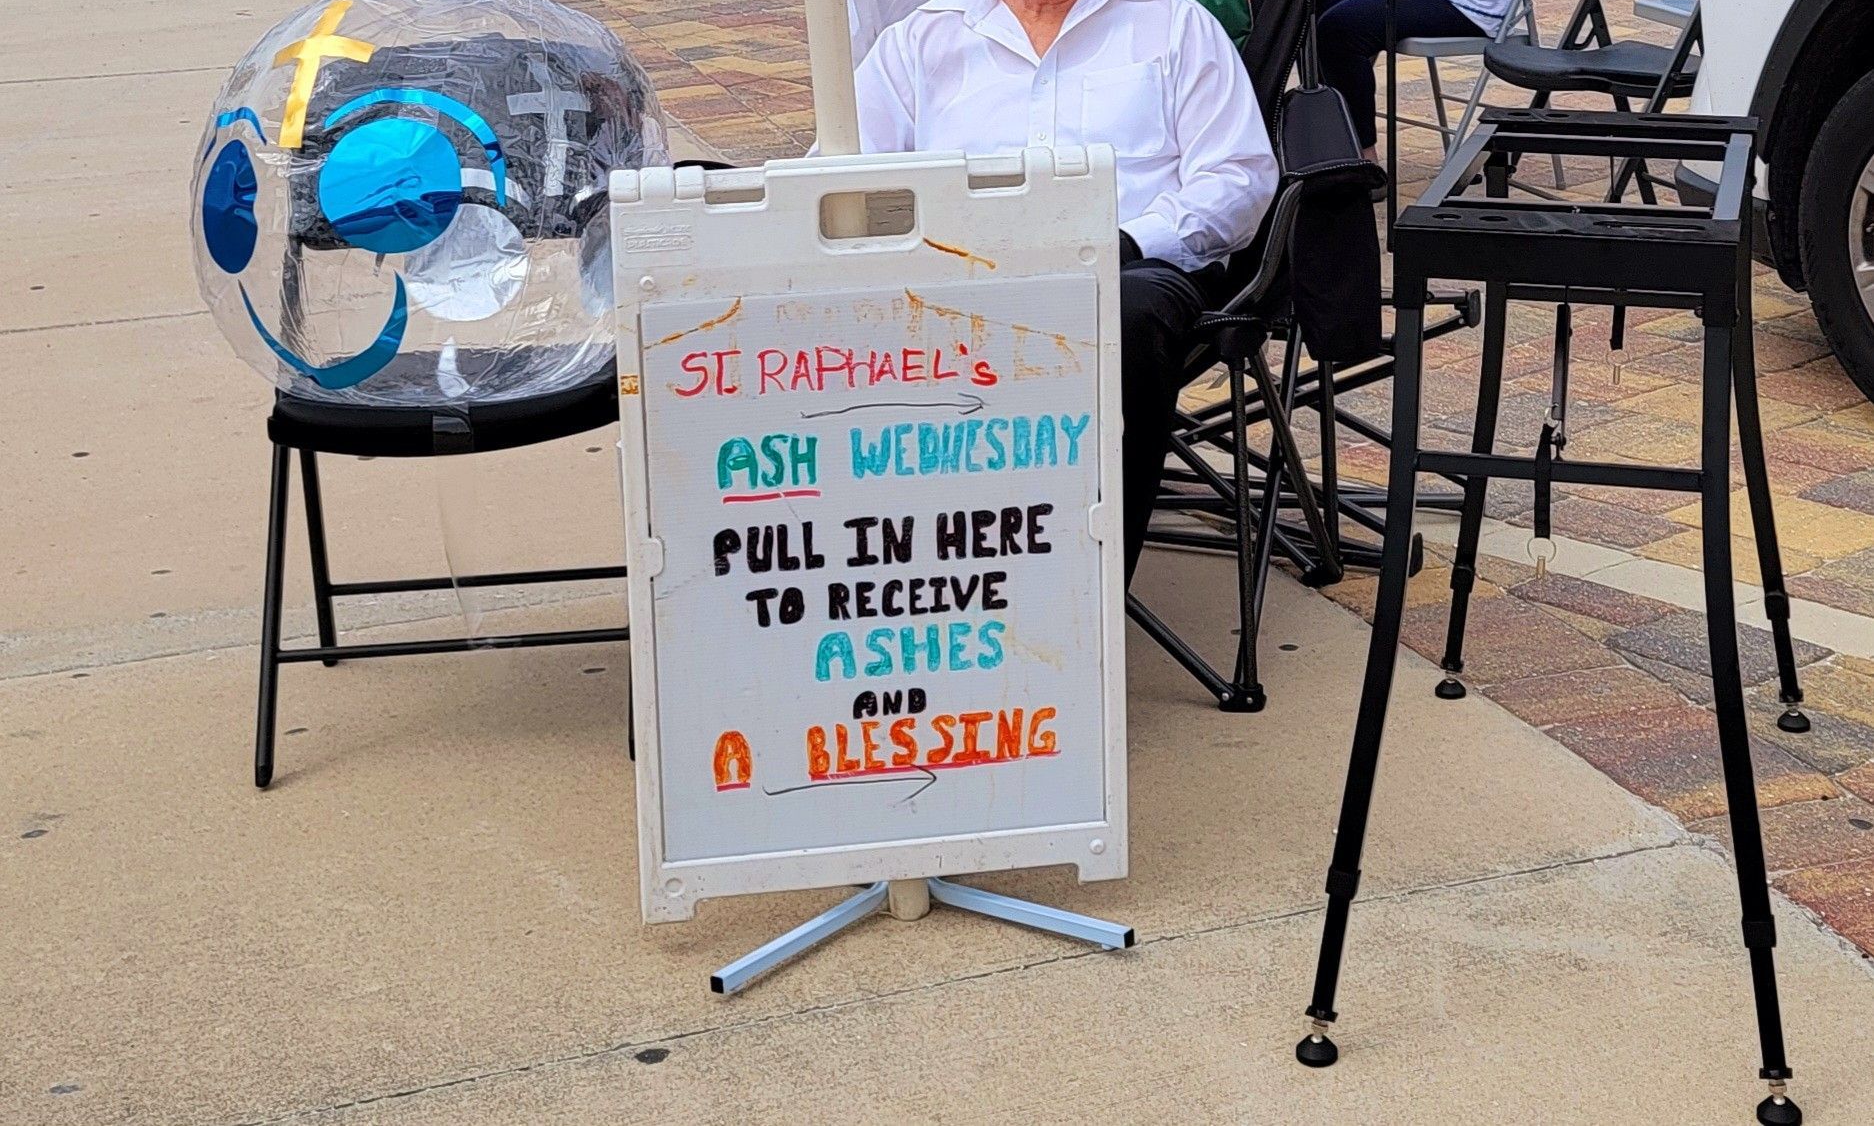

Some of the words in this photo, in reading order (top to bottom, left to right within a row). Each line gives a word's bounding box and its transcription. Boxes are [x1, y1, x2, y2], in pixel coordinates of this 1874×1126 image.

[717, 434, 819, 490] ASH
[849, 413, 1091, 481] WEDNESDAY
[714, 520, 825, 576] PULL
[843, 515, 915, 566] IN
[936, 503, 1054, 560] HERE
[745, 586, 805, 628] TO
[827, 570, 1009, 621] RECEIVE
[814, 619, 1007, 682] ASHES
[852, 687, 928, 719] AND
[714, 730, 752, 785] A
[806, 706, 1058, 776] BLESSING
